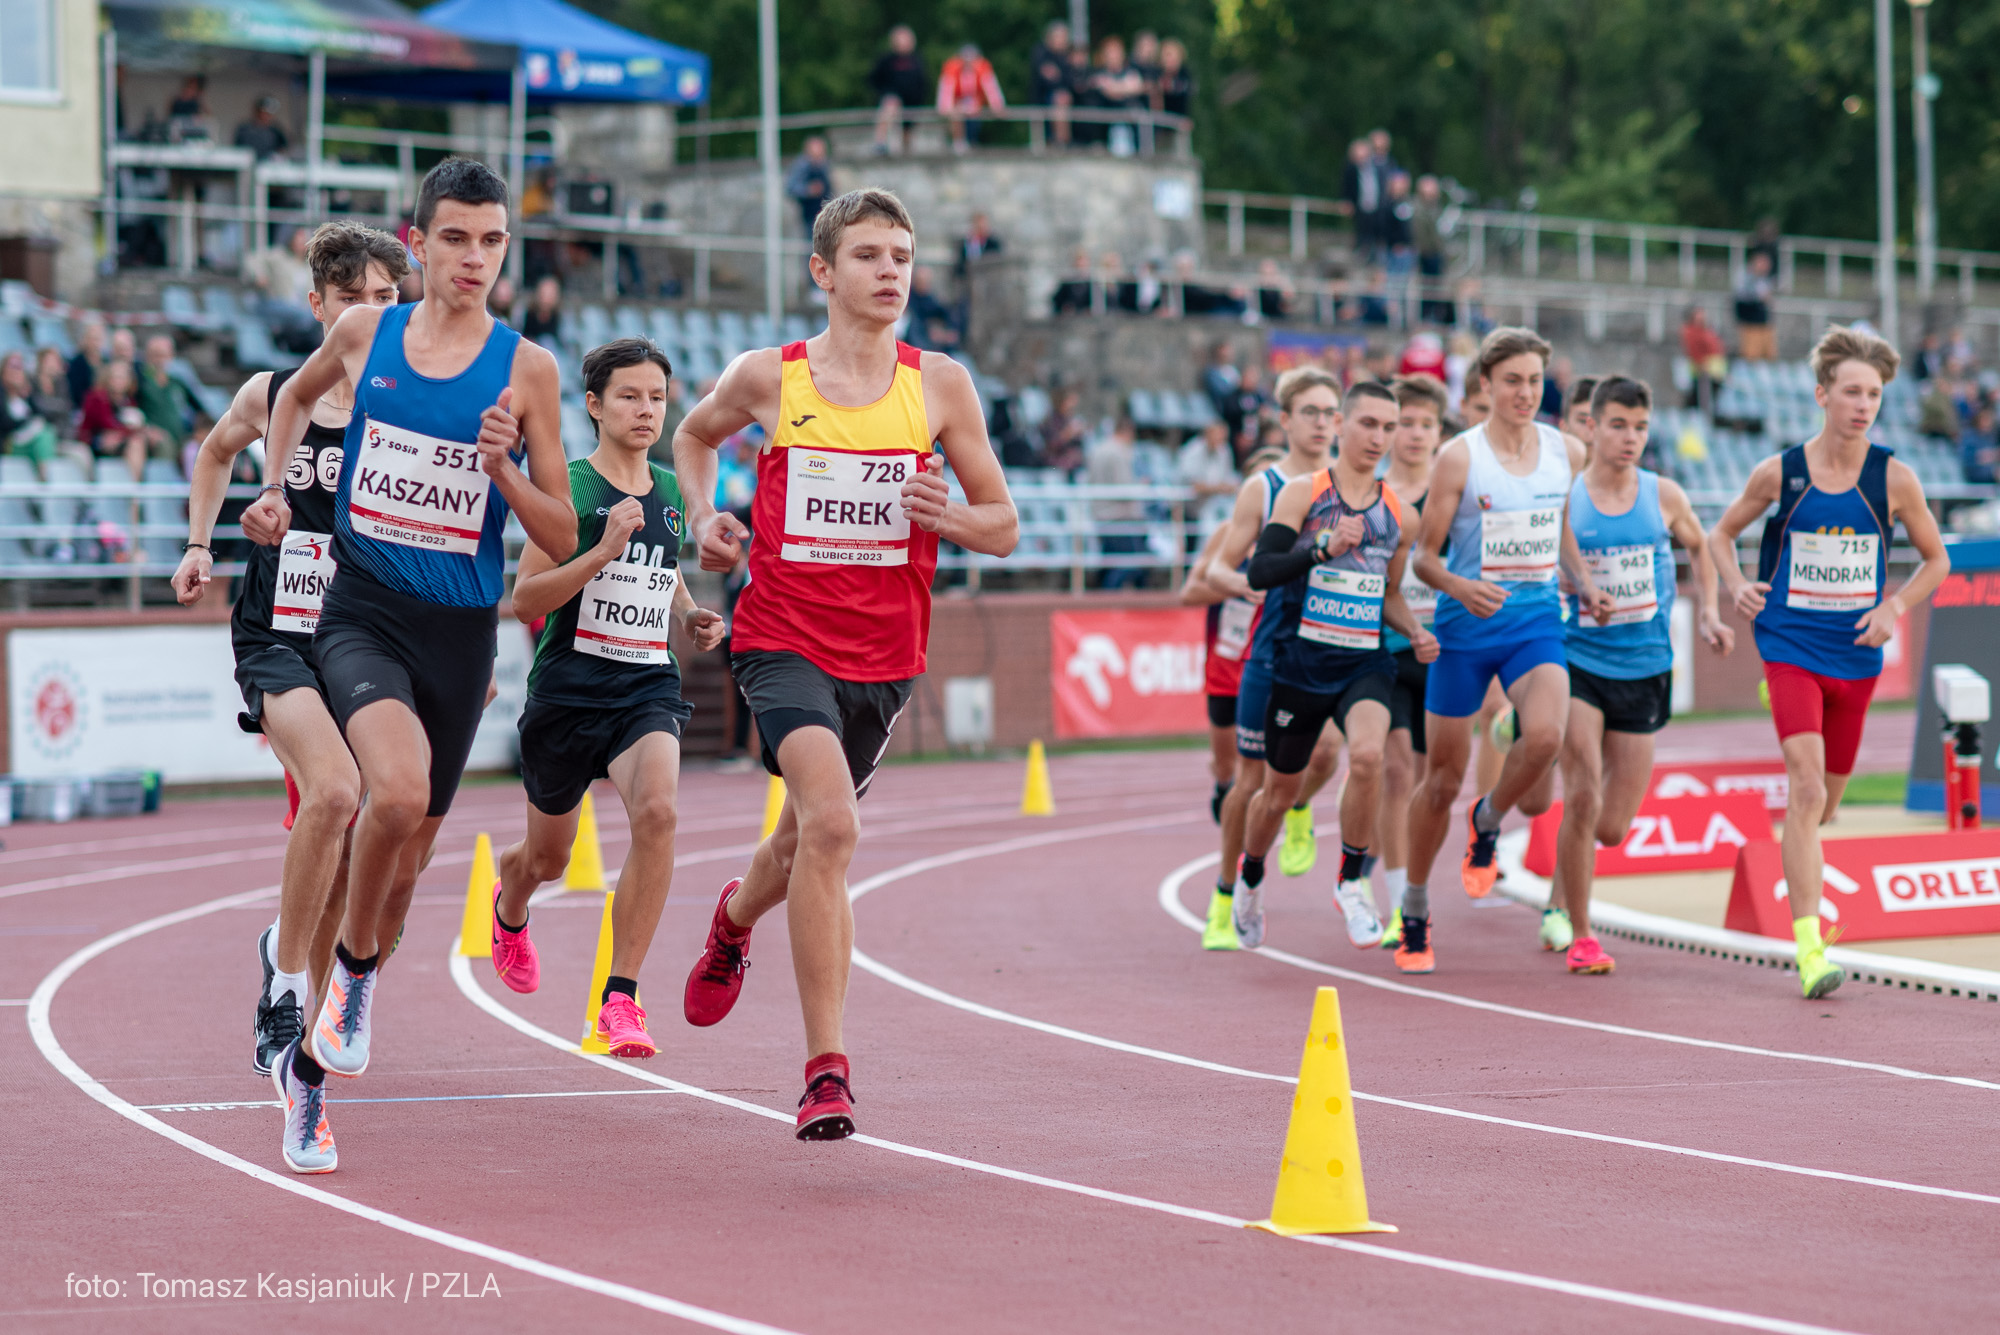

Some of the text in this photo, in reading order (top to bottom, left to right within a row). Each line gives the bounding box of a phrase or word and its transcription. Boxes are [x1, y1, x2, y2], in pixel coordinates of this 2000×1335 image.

[432, 445, 480, 473] 551
[808, 460, 827, 468] ZUO
[797, 473, 836, 481] INTERNATIONAL
[860, 461, 906, 483] 728
[357, 466, 482, 516] KASZANY
[805, 497, 893, 526] PEREK
[1530, 512, 1555, 528] 864
[373, 525, 447, 546] SŁUBICE 2023
[284, 548, 314, 558] polanik
[809, 550, 883, 562] SŁUBICE 2023
[1840, 539, 1870, 555] 715
[1620, 553, 1649, 572] 943
[1793, 562, 1873, 583] MENDRAK
[647, 572, 674, 592] 599
[1357, 578, 1381, 593] 622
[593, 598, 666, 629] TROJAK
[1307, 595, 1381, 622] OKRUCIŃSKI
[600, 645, 635, 659] SŁUBICE
[635, 651, 650, 659] 2023
[1594, 811, 1748, 858] ZLA
[1889, 868, 2000, 900] ORLE
